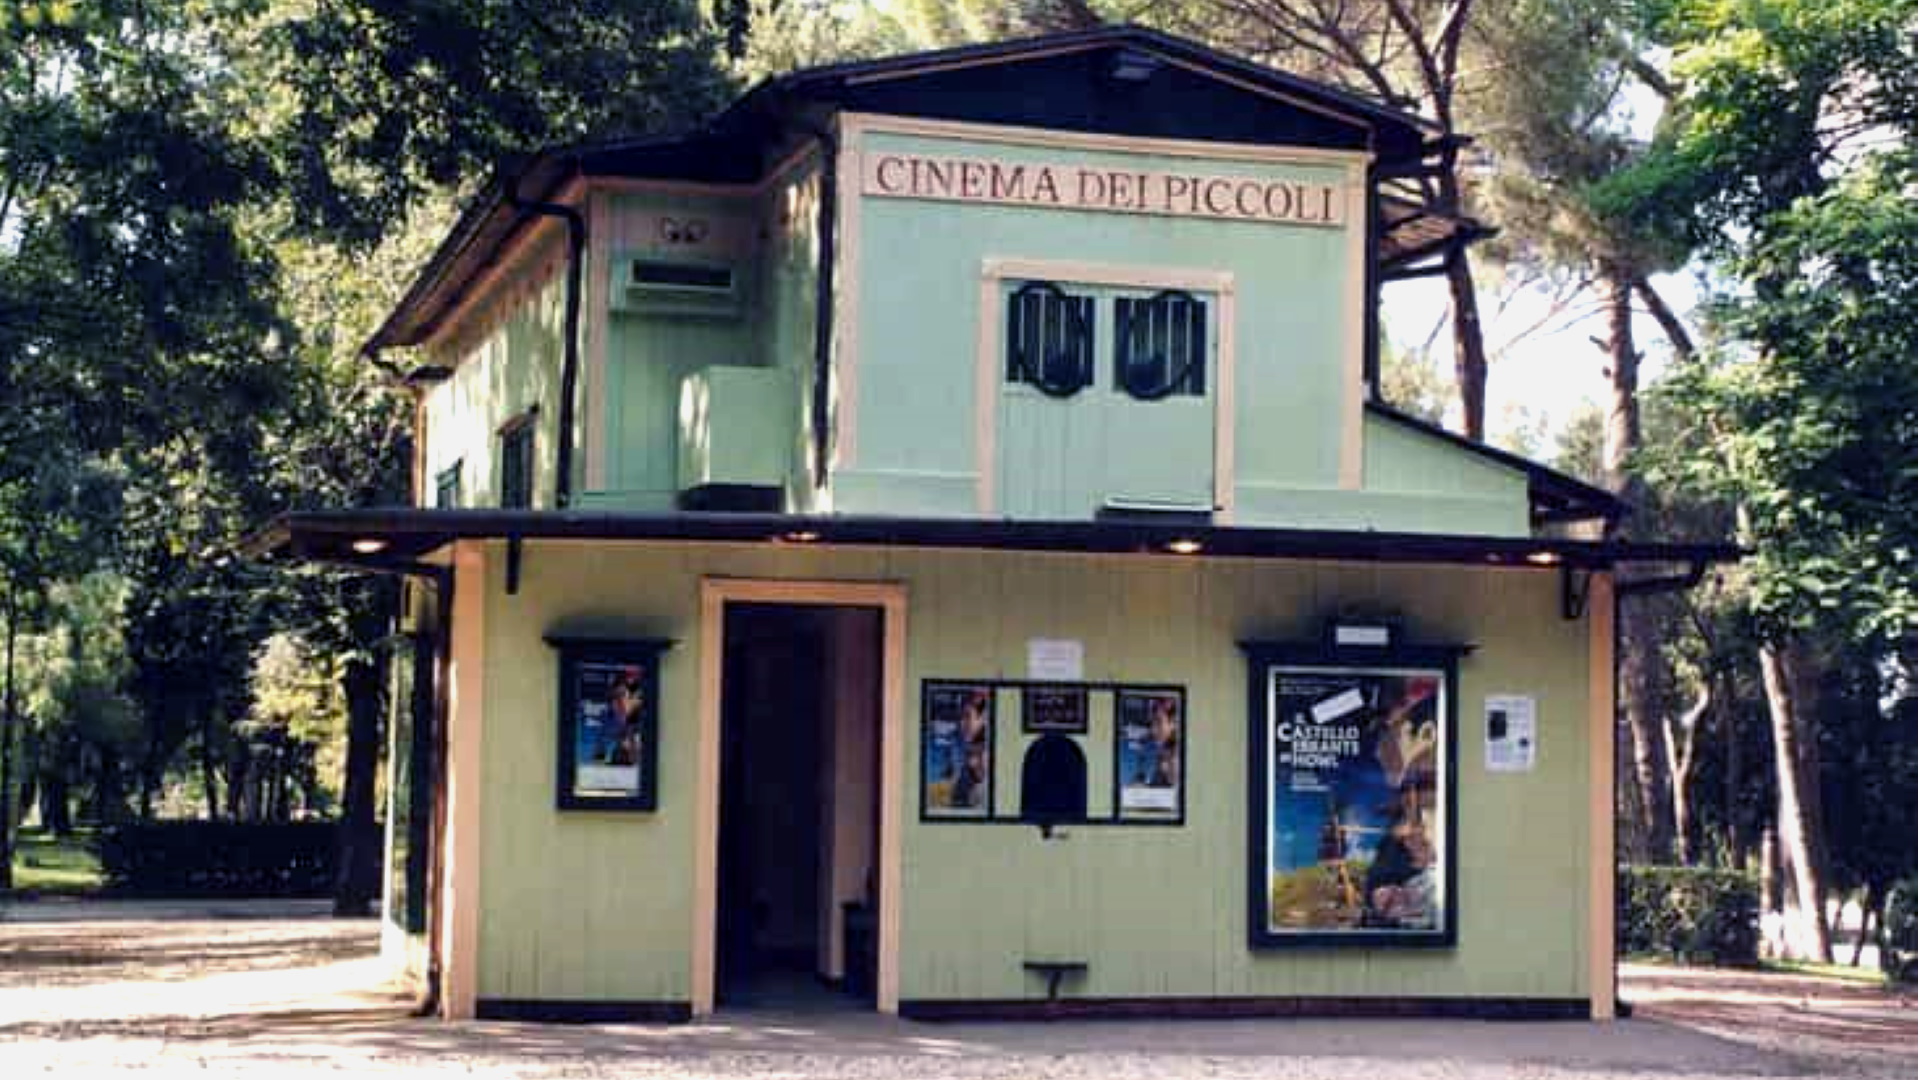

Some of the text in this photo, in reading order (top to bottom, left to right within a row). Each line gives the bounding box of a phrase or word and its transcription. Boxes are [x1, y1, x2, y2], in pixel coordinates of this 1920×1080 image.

[877, 157, 1333, 222] CINEMA DEI PICCOLI
